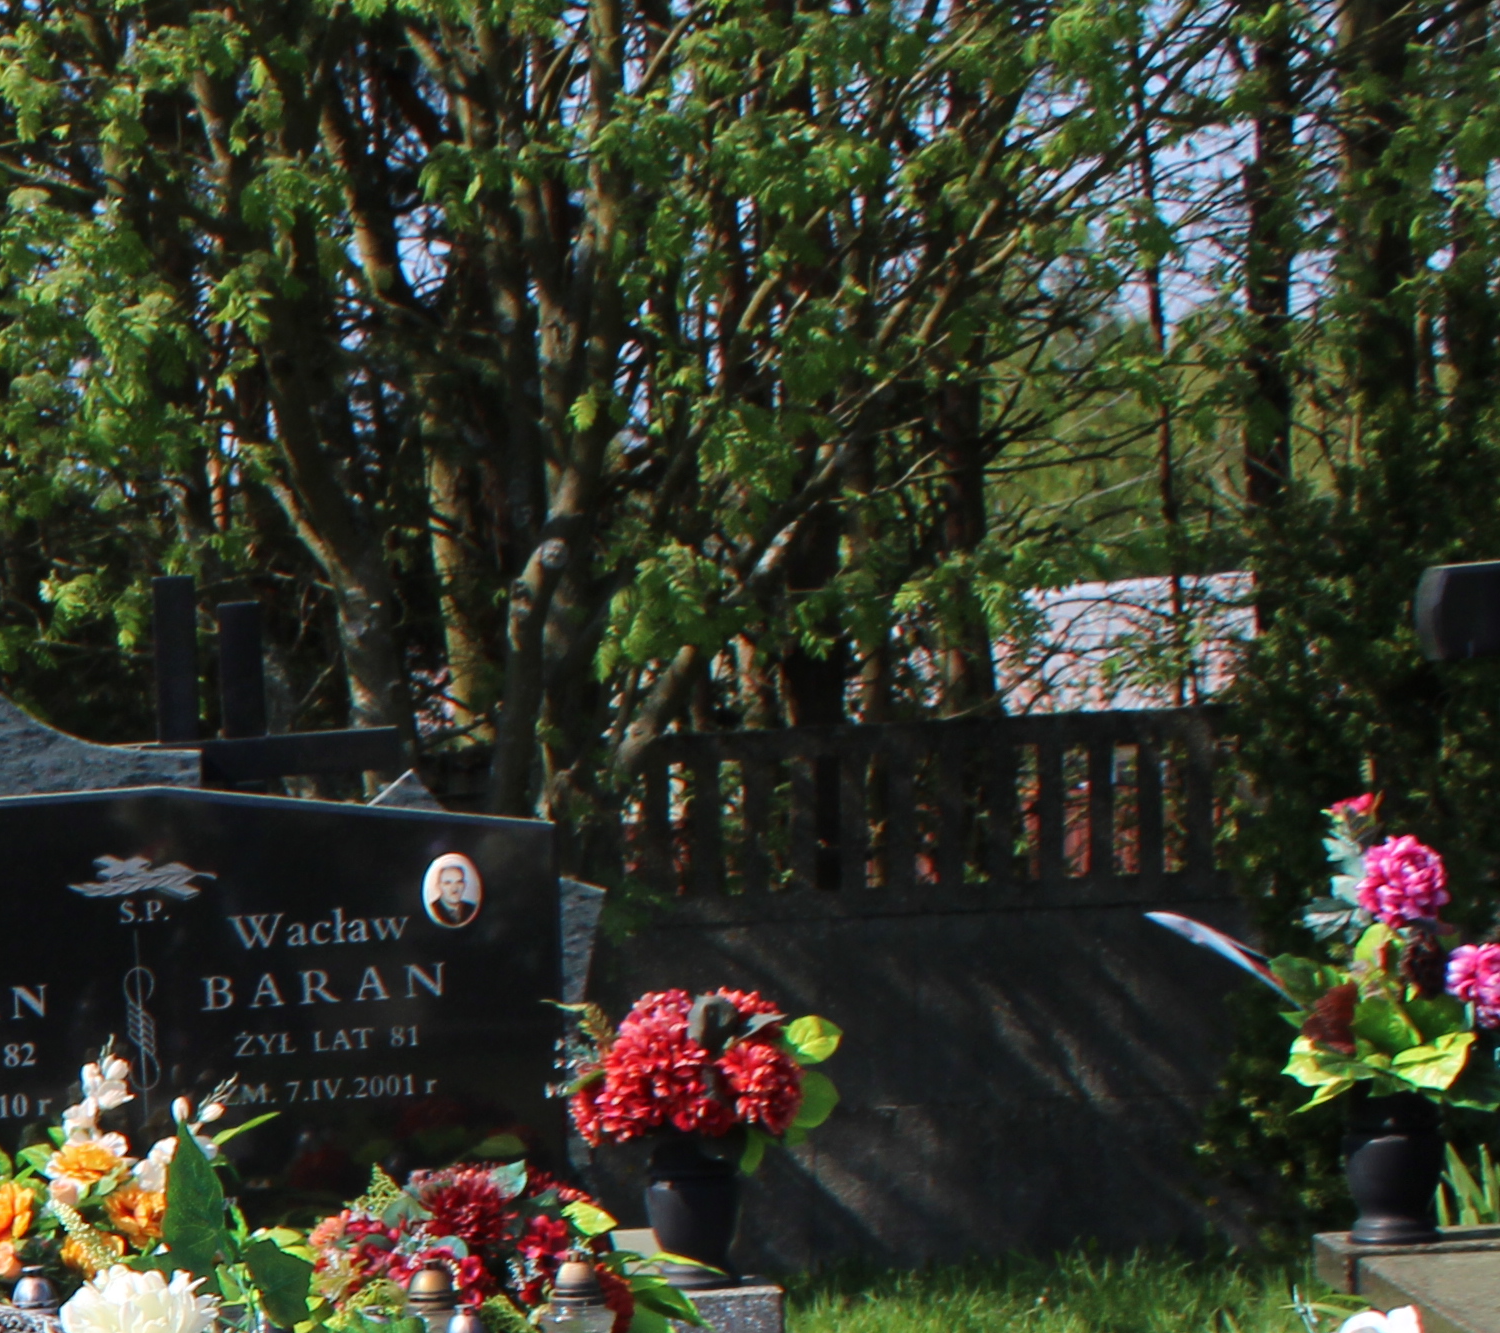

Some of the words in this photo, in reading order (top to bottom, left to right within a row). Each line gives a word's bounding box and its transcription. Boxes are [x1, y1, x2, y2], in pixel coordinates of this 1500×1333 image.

[228, 906, 410, 950] Wacław
[200, 961, 446, 1011] BARAN
[3, 1042, 37, 1068] 82
[234, 1031, 297, 1057] ŻYŁ
[312, 1028, 374, 1052] LAT
[390, 1025, 419, 1047] 81
[285, 1074, 415, 1103] 7.IV.2001
